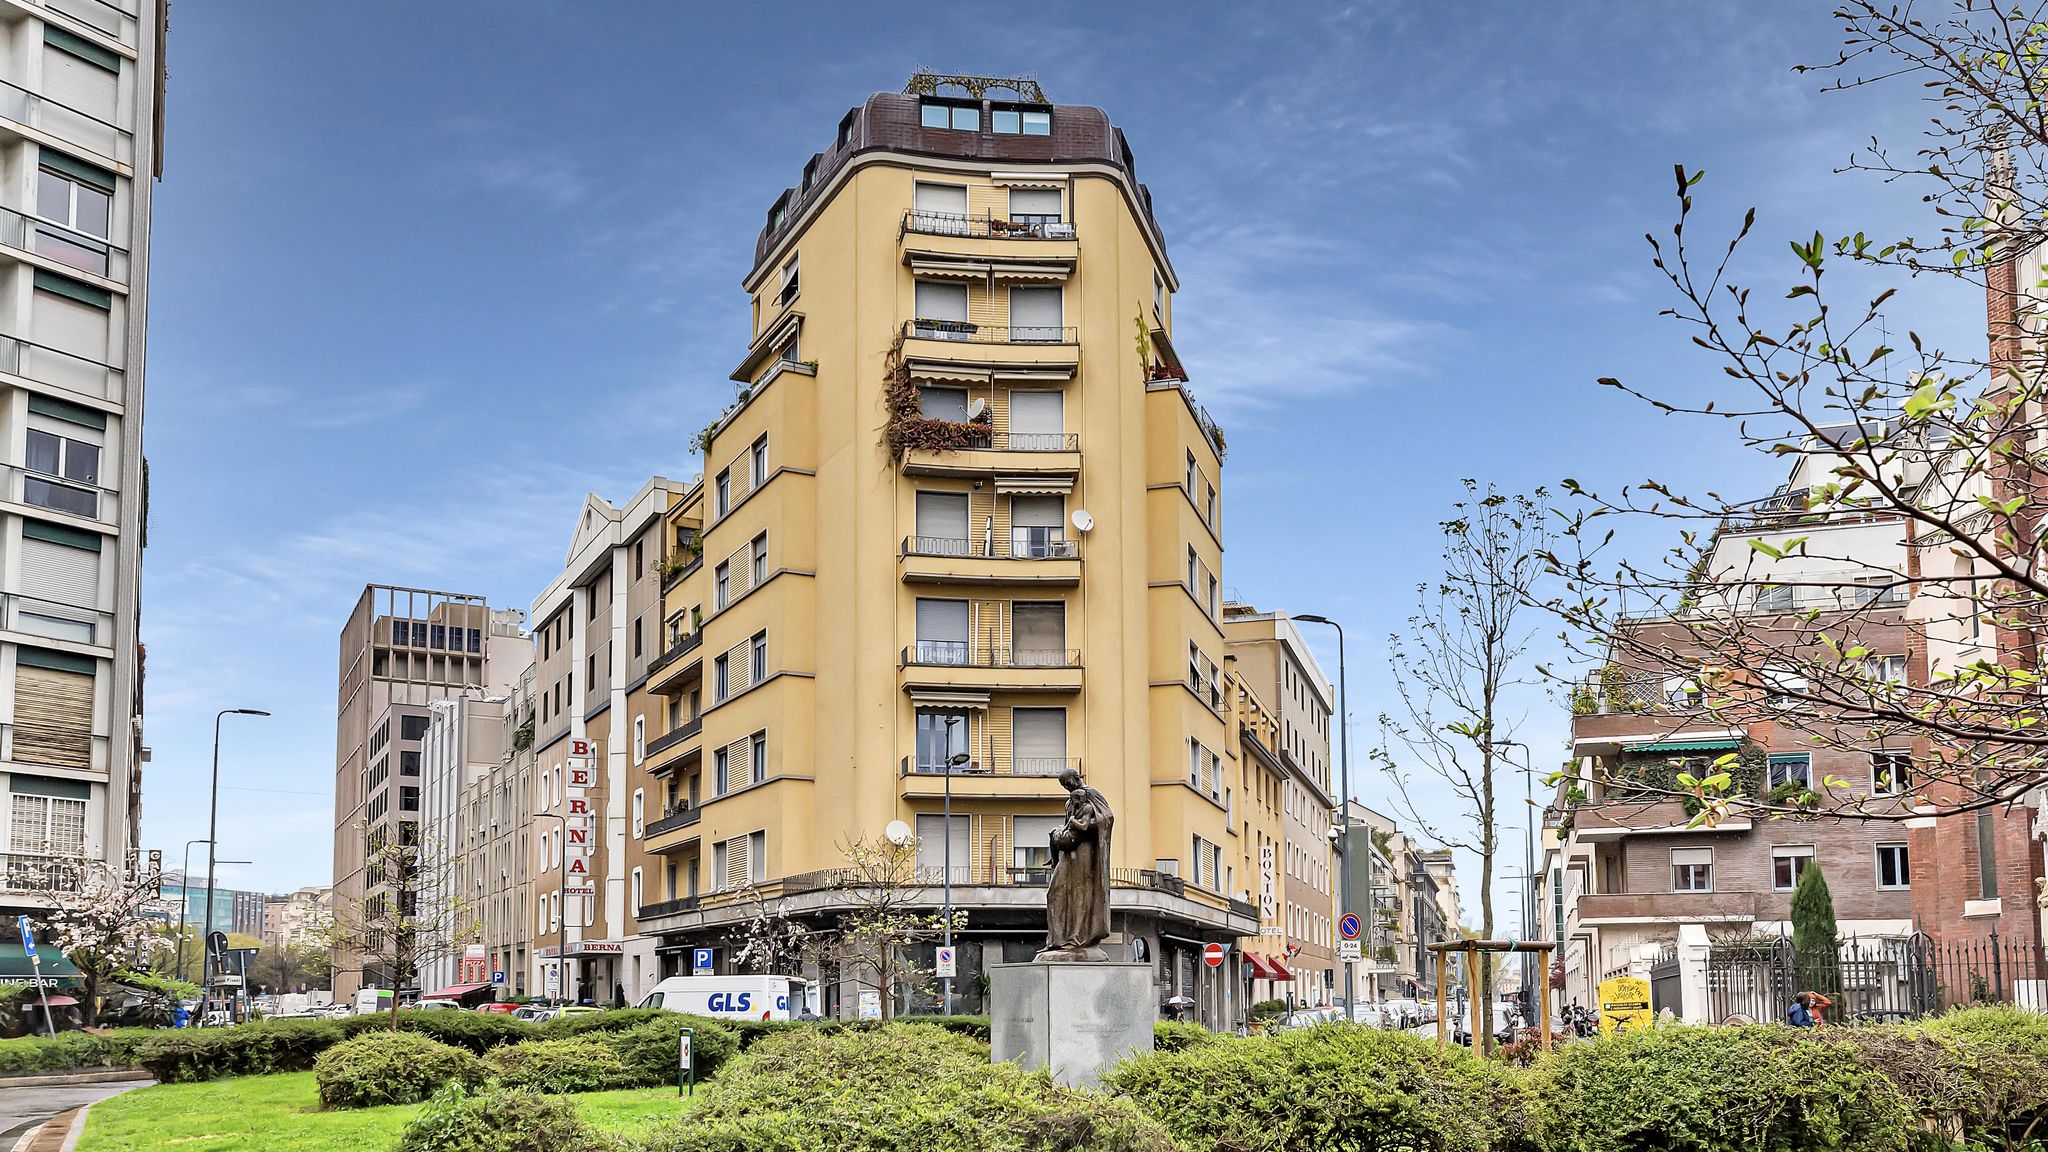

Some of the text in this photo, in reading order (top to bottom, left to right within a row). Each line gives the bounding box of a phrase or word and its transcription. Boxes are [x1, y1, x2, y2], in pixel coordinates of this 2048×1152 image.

[569, 741, 588, 873] BERNA
[1262, 848, 1273, 917] BOSTON
[583, 943, 623, 952] BERNA
[697, 951, 709, 967] P
[29, 978, 58, 988] BAR
[708, 992, 751, 1012] GLS
